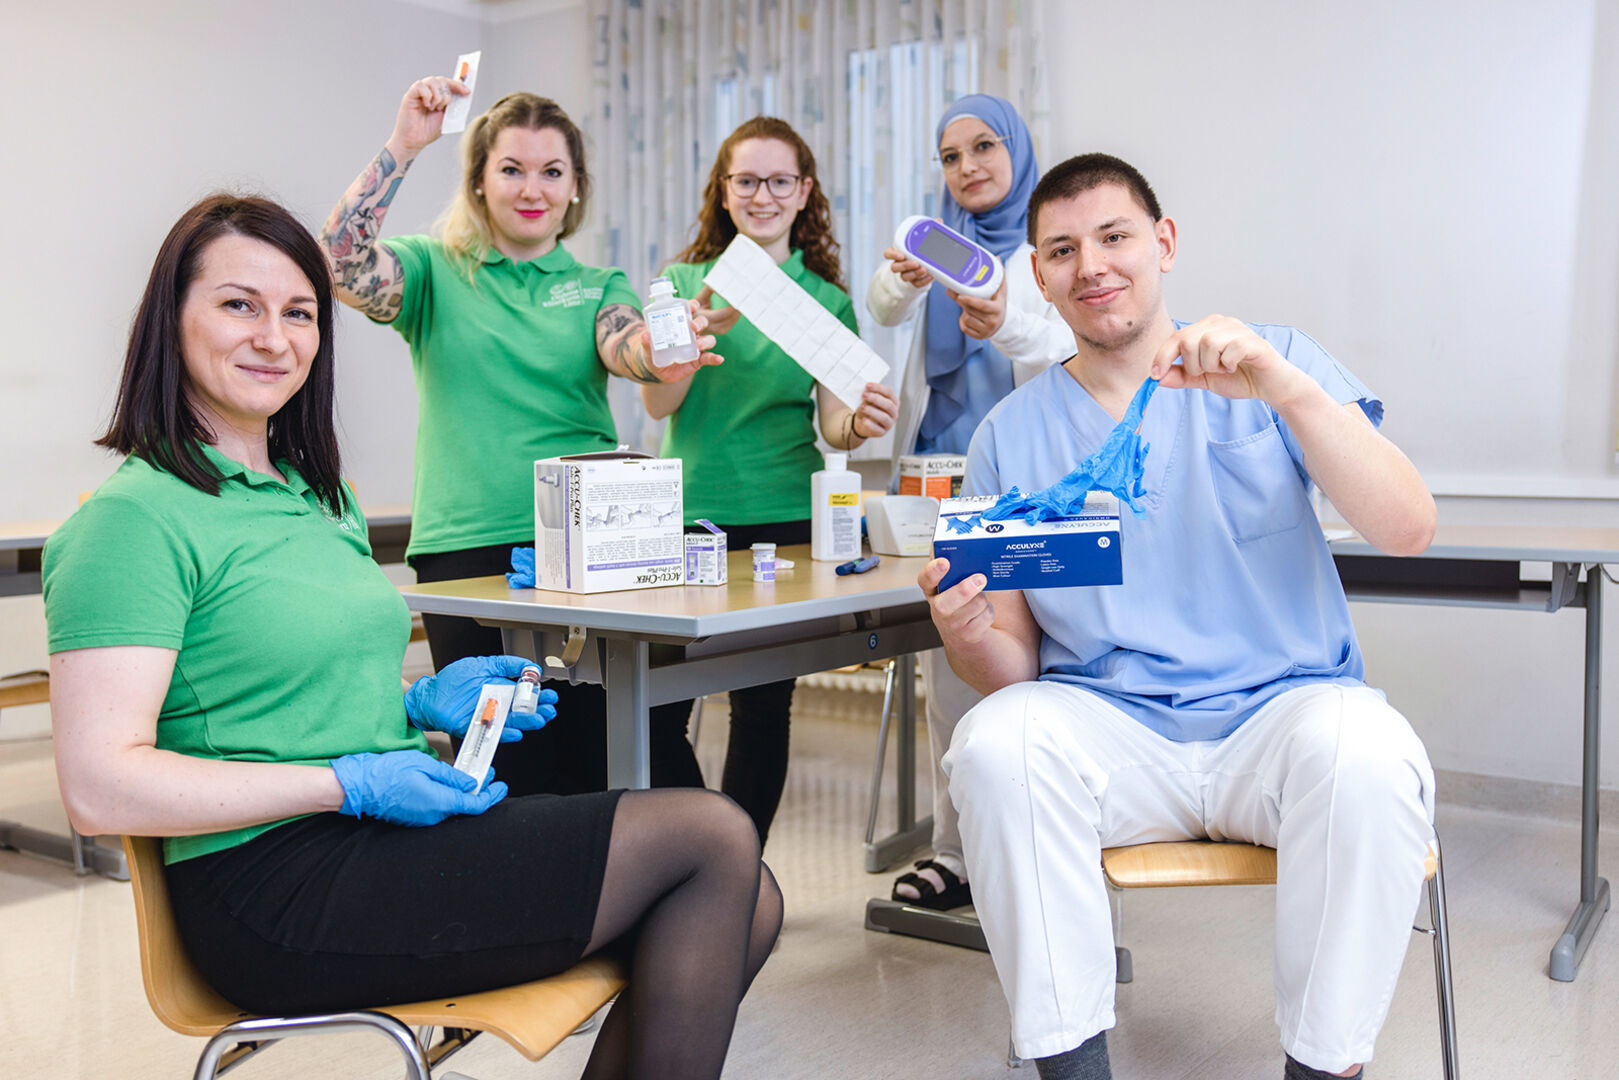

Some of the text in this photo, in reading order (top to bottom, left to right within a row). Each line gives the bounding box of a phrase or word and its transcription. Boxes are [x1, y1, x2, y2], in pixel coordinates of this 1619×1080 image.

[574, 465, 582, 526] ACCU-CHEK
[637, 572, 682, 584] ACCU-CHEK
[870, 635, 877, 648] 6
